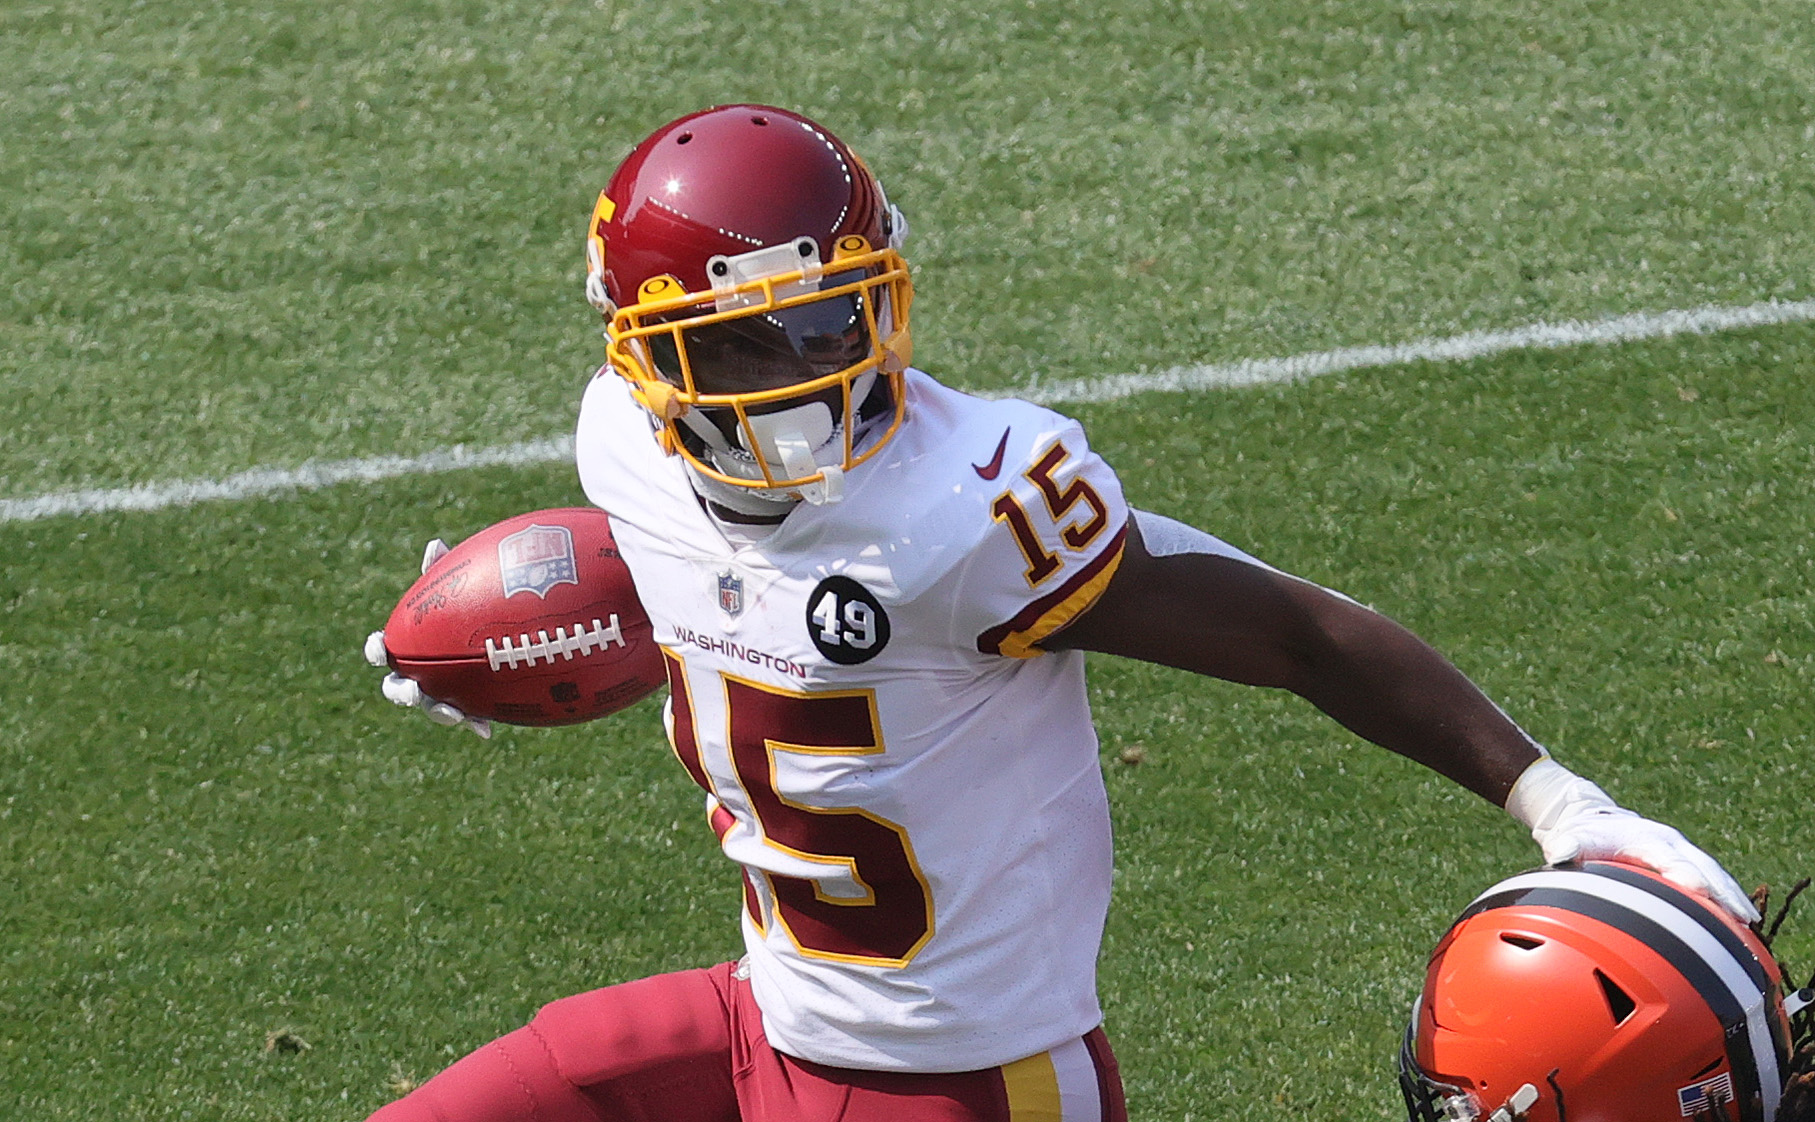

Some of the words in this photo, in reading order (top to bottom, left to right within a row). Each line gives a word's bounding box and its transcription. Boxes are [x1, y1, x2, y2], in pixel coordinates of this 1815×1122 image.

[990, 440, 1109, 589] 15
[721, 589, 739, 611] NFL
[812, 590, 877, 650] 49
[672, 624, 807, 680] WASHINGTON
